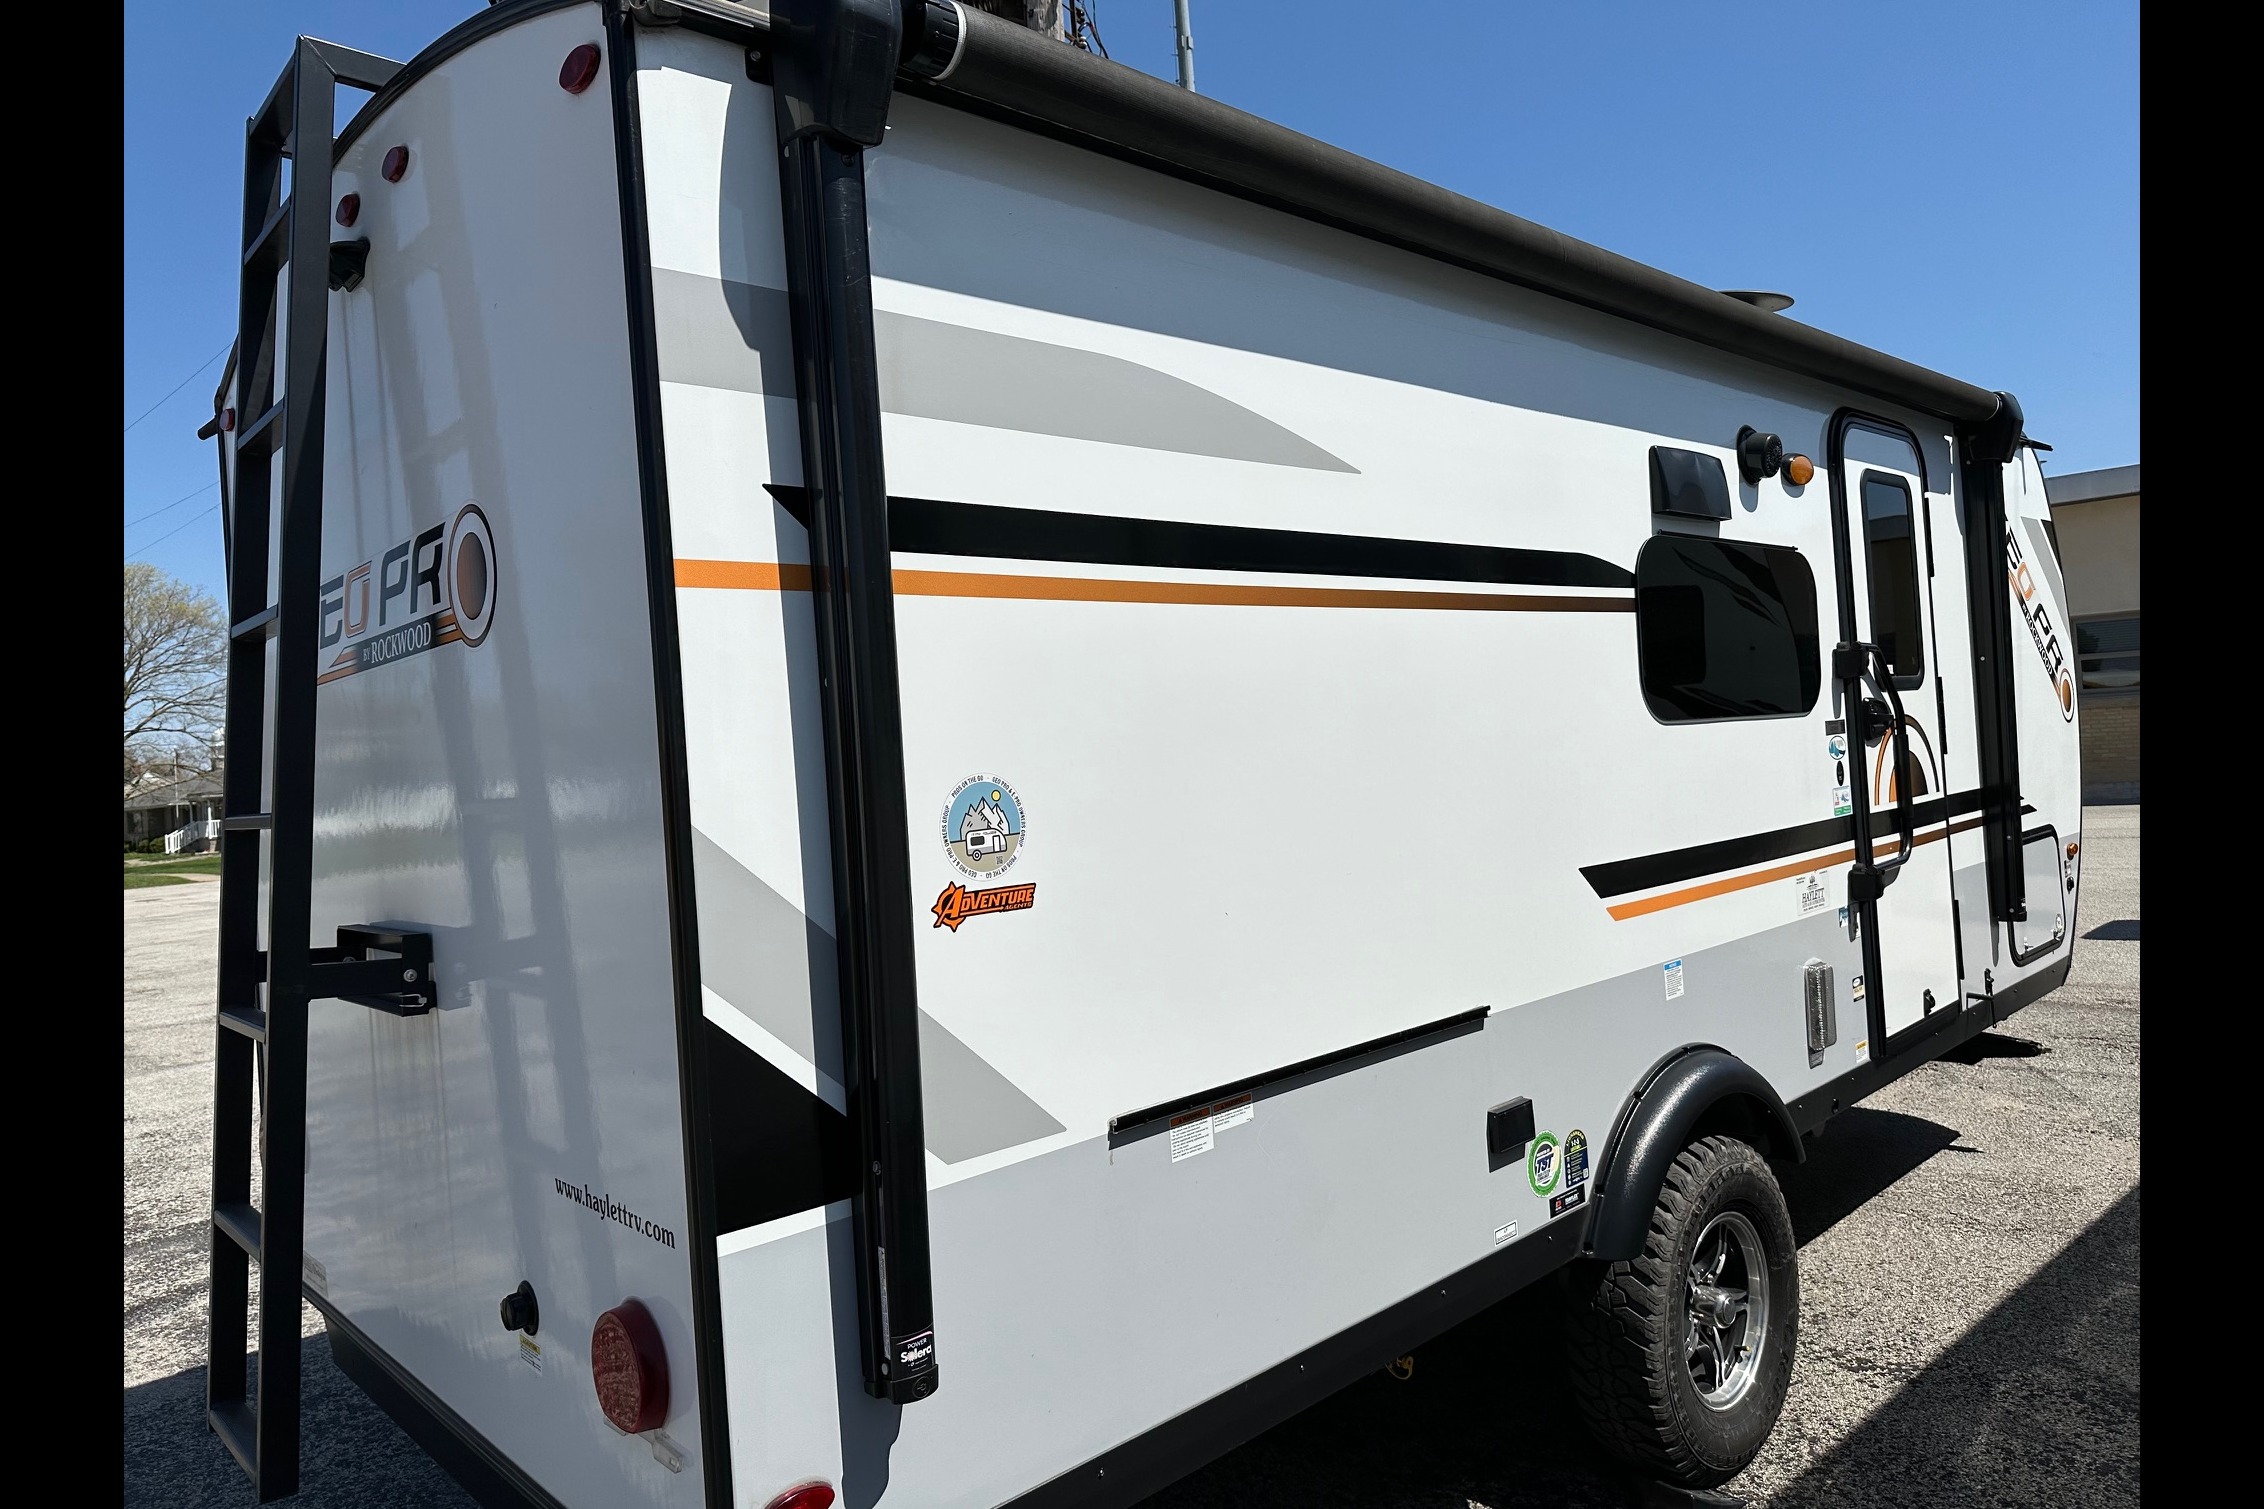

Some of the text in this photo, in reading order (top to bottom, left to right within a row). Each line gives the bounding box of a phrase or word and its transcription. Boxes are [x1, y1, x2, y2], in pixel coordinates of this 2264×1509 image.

[320, 503, 498, 650] EO PRO
[2005, 526, 2075, 723] EO PRO
[363, 622, 431, 663] BY ROCKWOOD
[2025, 612, 2053, 675] ROCKWOOD
[951, 774, 984, 798] PROS ON THE GO
[1007, 854, 1017, 866] PROS
[993, 869, 1002, 878] THE
[934, 886, 1034, 926] ADVENTURE
[1004, 902, 1032, 910] AGENTS
[1801, 887, 1825, 903] HAYLETT
[1536, 1152, 1554, 1174] TST
[555, 1178, 676, 1249] www.haylettrv.com
[907, 1337, 927, 1349] POWER
